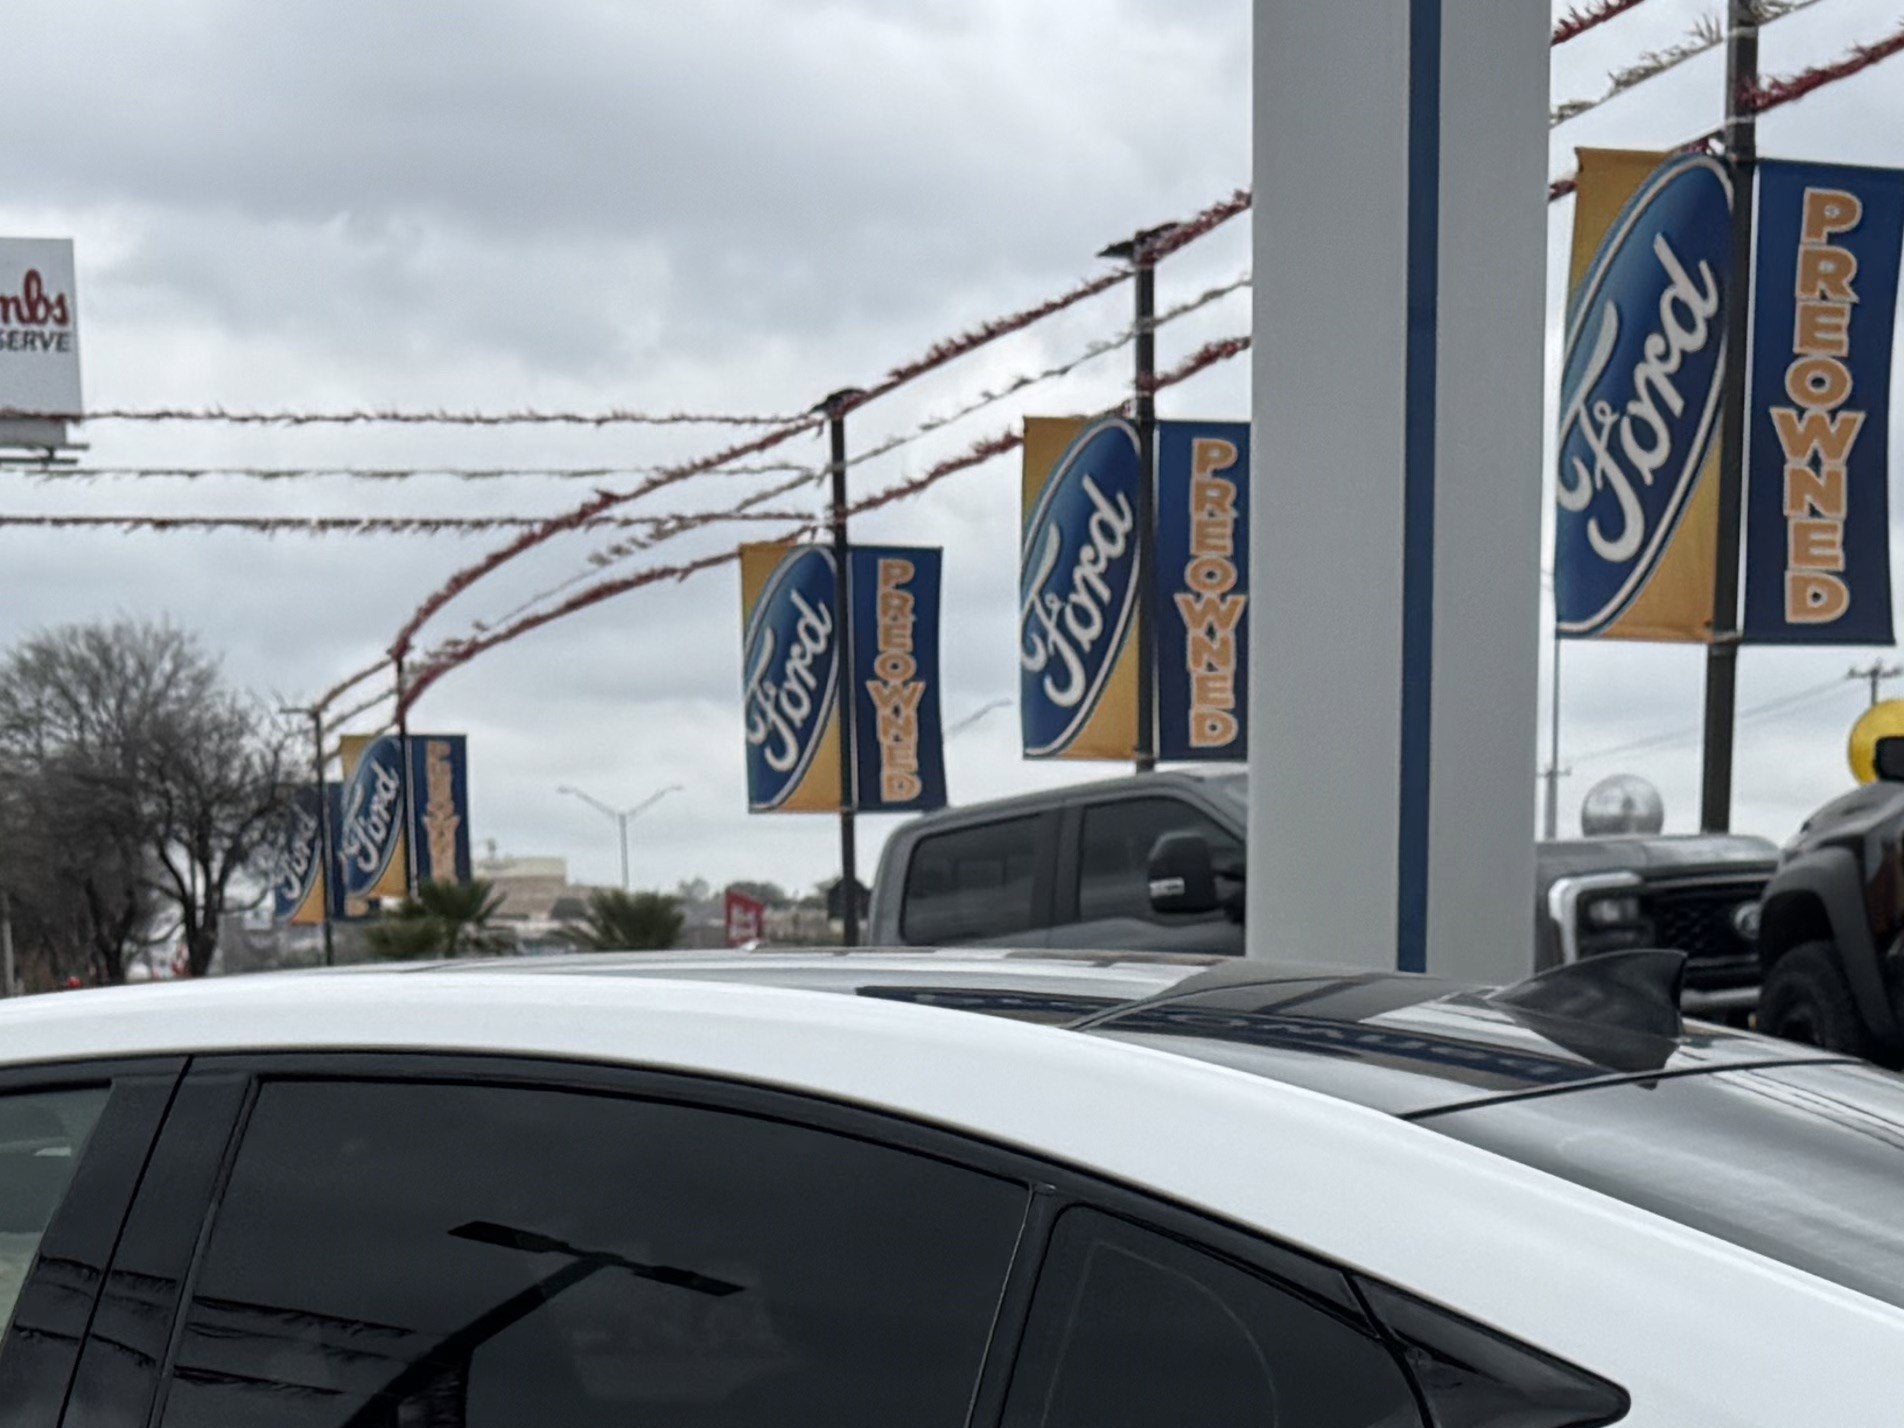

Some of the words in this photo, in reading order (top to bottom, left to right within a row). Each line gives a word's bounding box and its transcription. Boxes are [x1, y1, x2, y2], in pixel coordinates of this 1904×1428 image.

[1555, 232, 1719, 563] Ford
[745, 589, 833, 772] Ford
[1021, 474, 1135, 708] Ford
[344, 760, 400, 873] Ford
